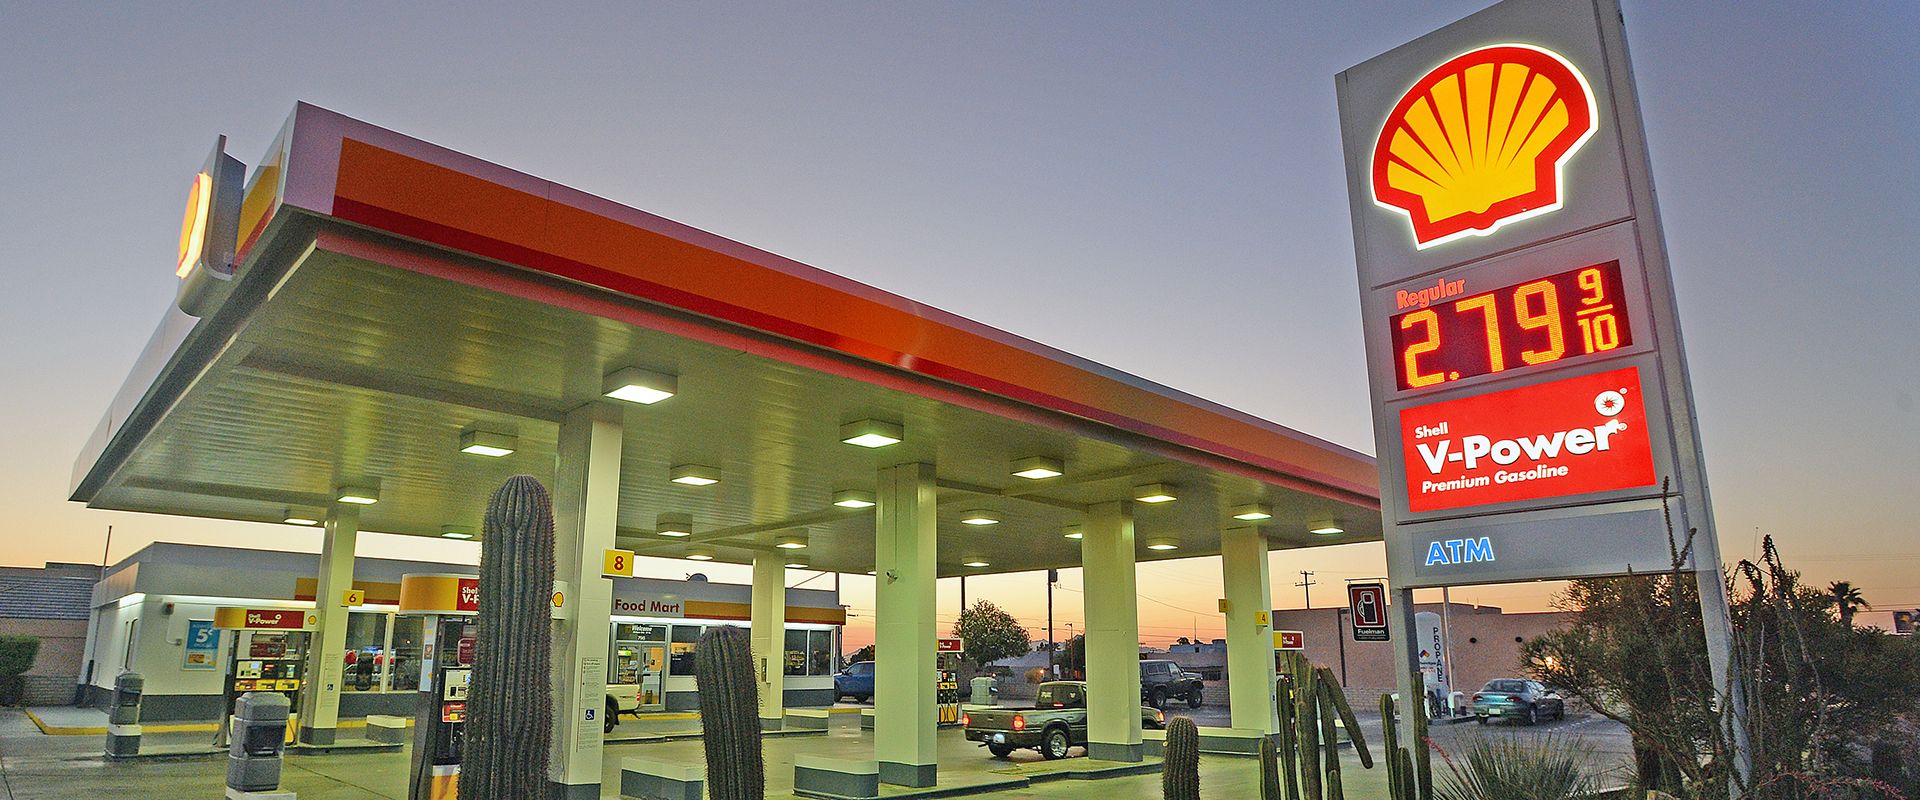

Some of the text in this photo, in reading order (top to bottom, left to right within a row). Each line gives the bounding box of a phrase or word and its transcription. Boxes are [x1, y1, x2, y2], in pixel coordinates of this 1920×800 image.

[1396, 278, 1466, 310] Regular
[1577, 267, 1605, 306] 9
[1400, 279, 1566, 389] 2.79
[1577, 311, 1620, 355] 10
[1415, 422, 1449, 439] Shell
[1416, 419, 1622, 475] V-Power
[1421, 464, 1569, 494] Premium Gasoline
[614, 555, 624, 571] 8
[1425, 537, 1496, 566] ATM
[348, 593, 357, 603] 6
[462, 586, 479, 594] Shel
[614, 599, 680, 613] Food Mart
[248, 617, 279, 625] V-Power
[1433, 627, 1444, 683] PROPANE
